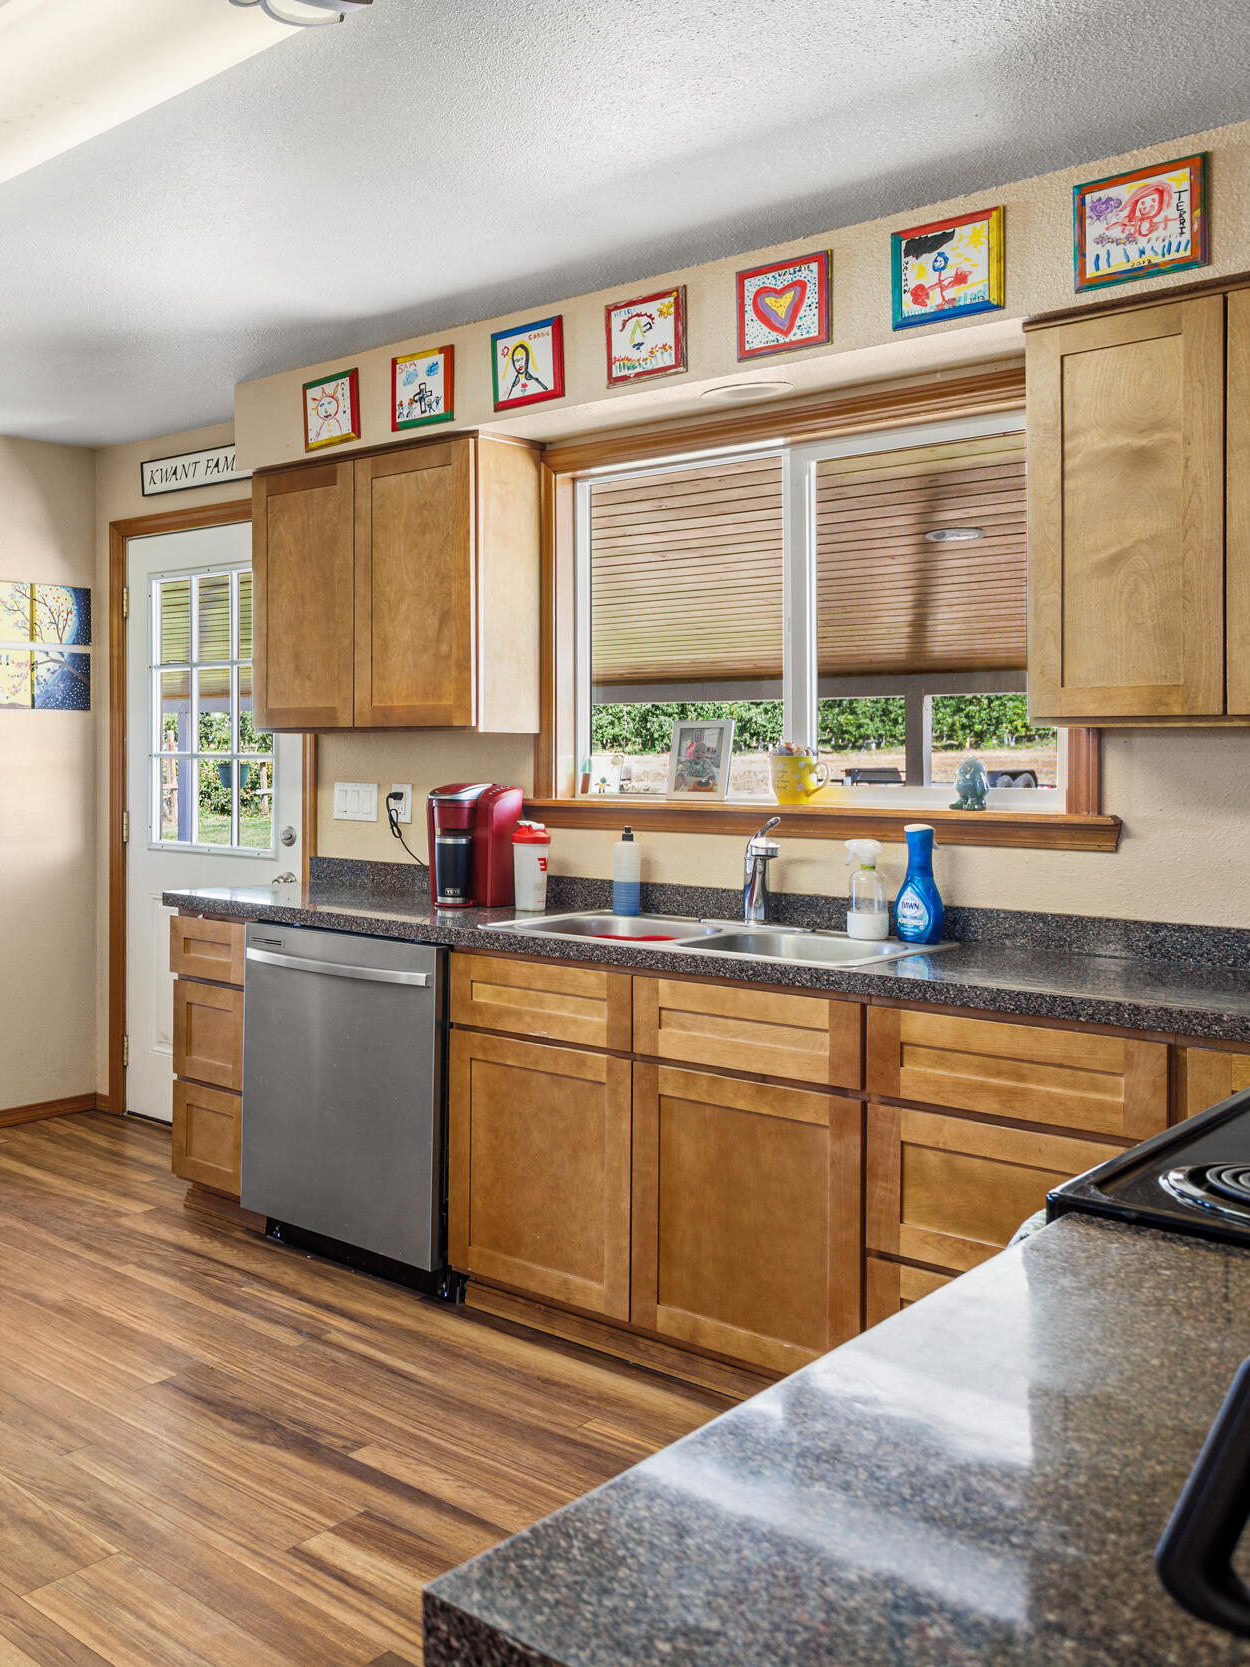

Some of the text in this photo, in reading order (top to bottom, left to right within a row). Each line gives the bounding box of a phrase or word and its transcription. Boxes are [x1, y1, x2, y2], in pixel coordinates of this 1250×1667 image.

[1174, 189, 1189, 237] TERRI
[398, 361, 417, 374] SAM
[148, 460, 200, 486] KWANT
[901, 901, 920, 910] DAWN
